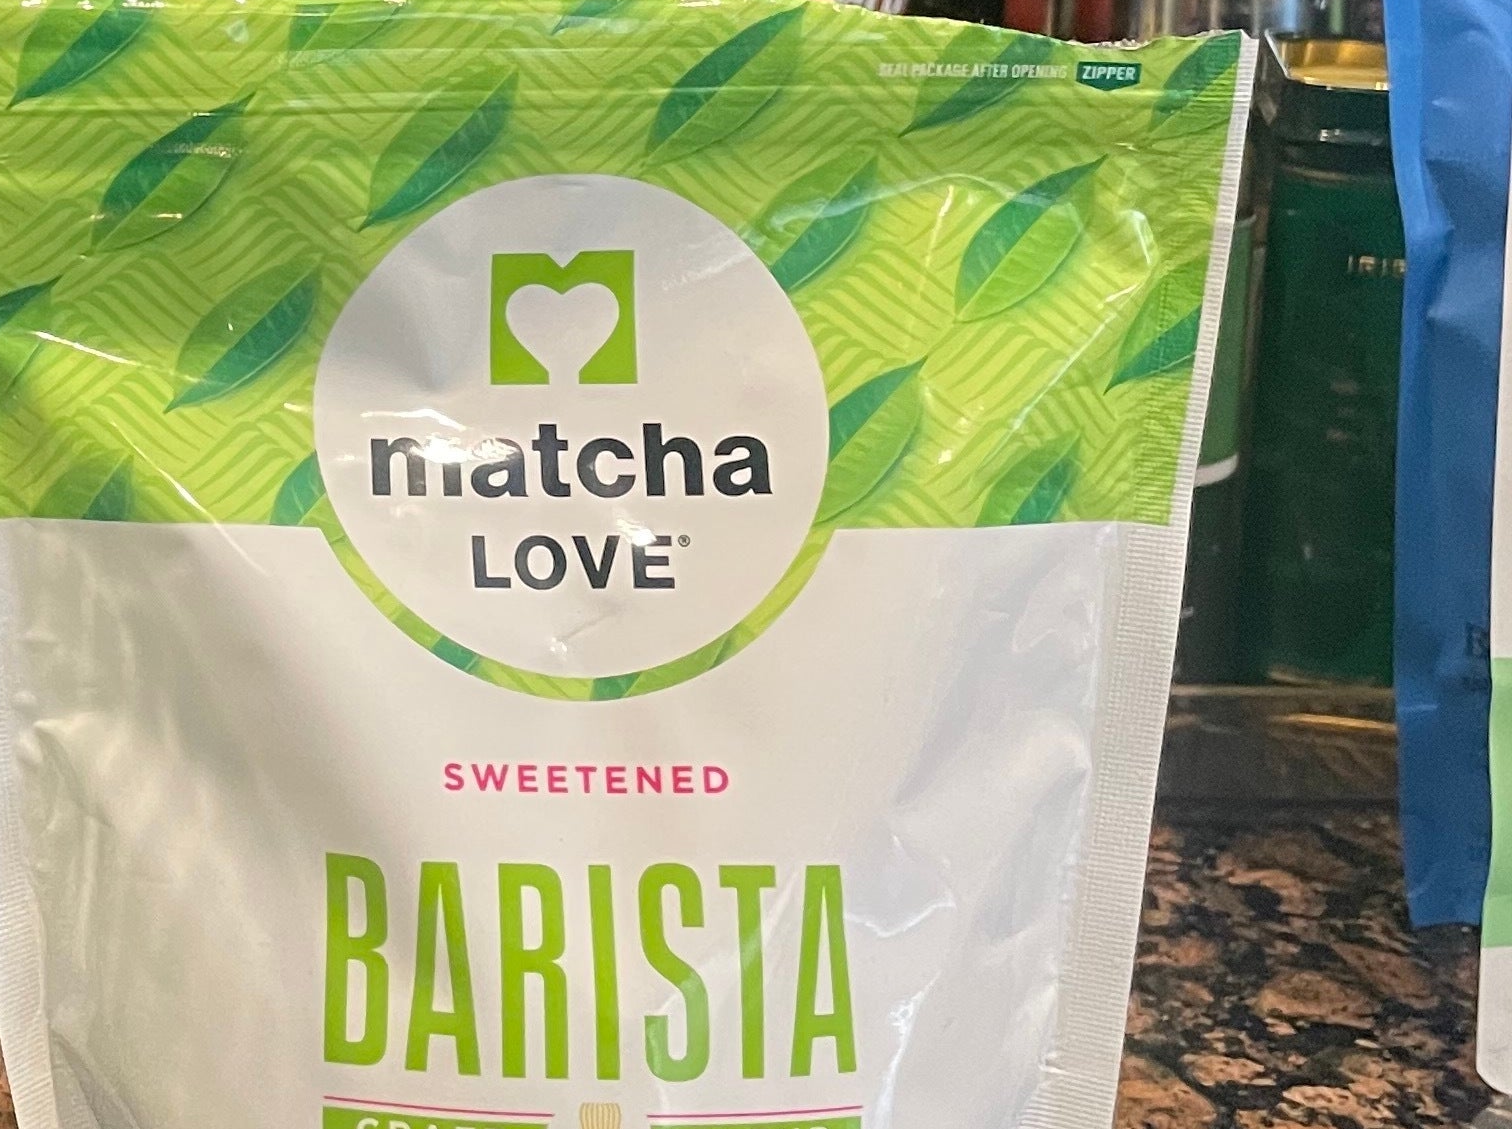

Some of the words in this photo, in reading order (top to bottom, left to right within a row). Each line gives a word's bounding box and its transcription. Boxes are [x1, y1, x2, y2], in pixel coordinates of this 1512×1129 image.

[912, 62, 969, 78] PACKAGE
[972, 63, 1008, 79] AFTER
[1011, 64, 1068, 80] OPENING
[1082, 65, 1137, 81] ZIPPER
[369, 422, 774, 499] matcha
[443, 761, 731, 795] SWEETENED
[323, 851, 857, 1082] BARISTA
